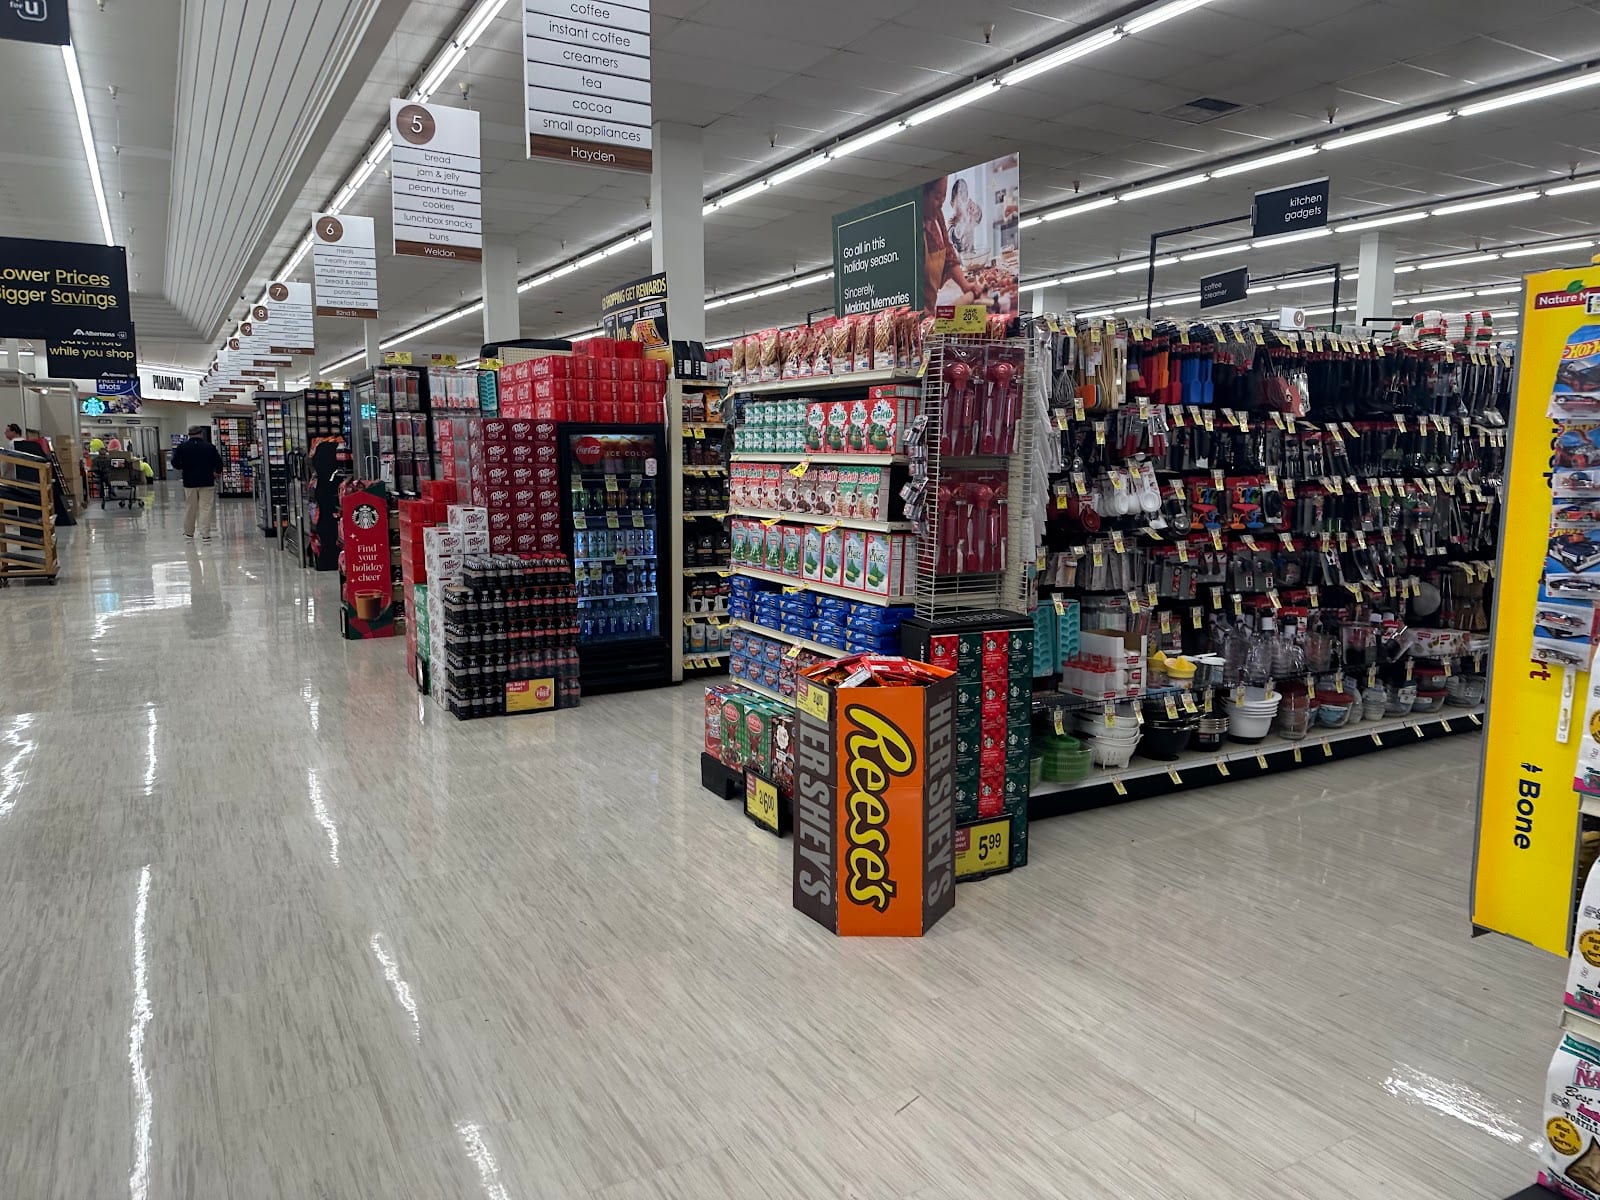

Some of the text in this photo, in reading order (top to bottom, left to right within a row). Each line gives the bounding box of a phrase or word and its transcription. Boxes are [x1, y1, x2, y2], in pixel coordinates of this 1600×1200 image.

[570, 3, 610, 19] coffee
[549, 21, 631, 47] instant coffee
[562, 50, 619, 69] creamers
[582, 75, 602, 89] tea
[572, 100, 612, 114] cocoa
[411, 115, 423, 133] 5
[543, 118, 641, 142] small appliances
[424, 153, 451, 164] bread
[570, 146, 616, 162] Hayden
[416, 167, 460, 183] jam & jelly
[408, 183, 468, 198] peanut butter
[422, 200, 455, 211] cookies
[1289, 194, 1322, 207] kitchen
[403, 213, 473, 229] lunchbox snacks
[1284, 207, 1322, 222] gadgets
[326, 223, 335, 235] 6
[429, 231, 450, 242] buns
[424, 247, 456, 258] Weldon
[843, 236, 886, 259] Go all in this
[843, 251, 900, 275] holiday season.
[55, 269, 111, 286] Prices
[275, 287, 282, 297] 7
[626, 285, 636, 301] GET
[636, 277, 667, 299] REWARDS
[844, 283, 875, 300] Sincerely,
[1203, 281, 1223, 291] coffee
[51, 288, 117, 310] Savings
[1203, 289, 1227, 299] creamer
[1539, 294, 1578, 306] Nature
[844, 291, 910, 316] Making Memories
[258, 309, 265, 317] 8
[963, 313, 979, 321] 20%
[49, 346, 135, 361] while you shop
[98, 383, 121, 391] shots
[152, 374, 185, 392] PHARMACY
[357, 544, 377, 553] Find
[358, 554, 378, 564] your
[352, 562, 384, 573] holiday
[357, 573, 381, 582] cheer
[849, 707, 914, 909] Reese's
[928, 697, 953, 906] HERSHEY'S
[1513, 778, 1541, 850] Bone
